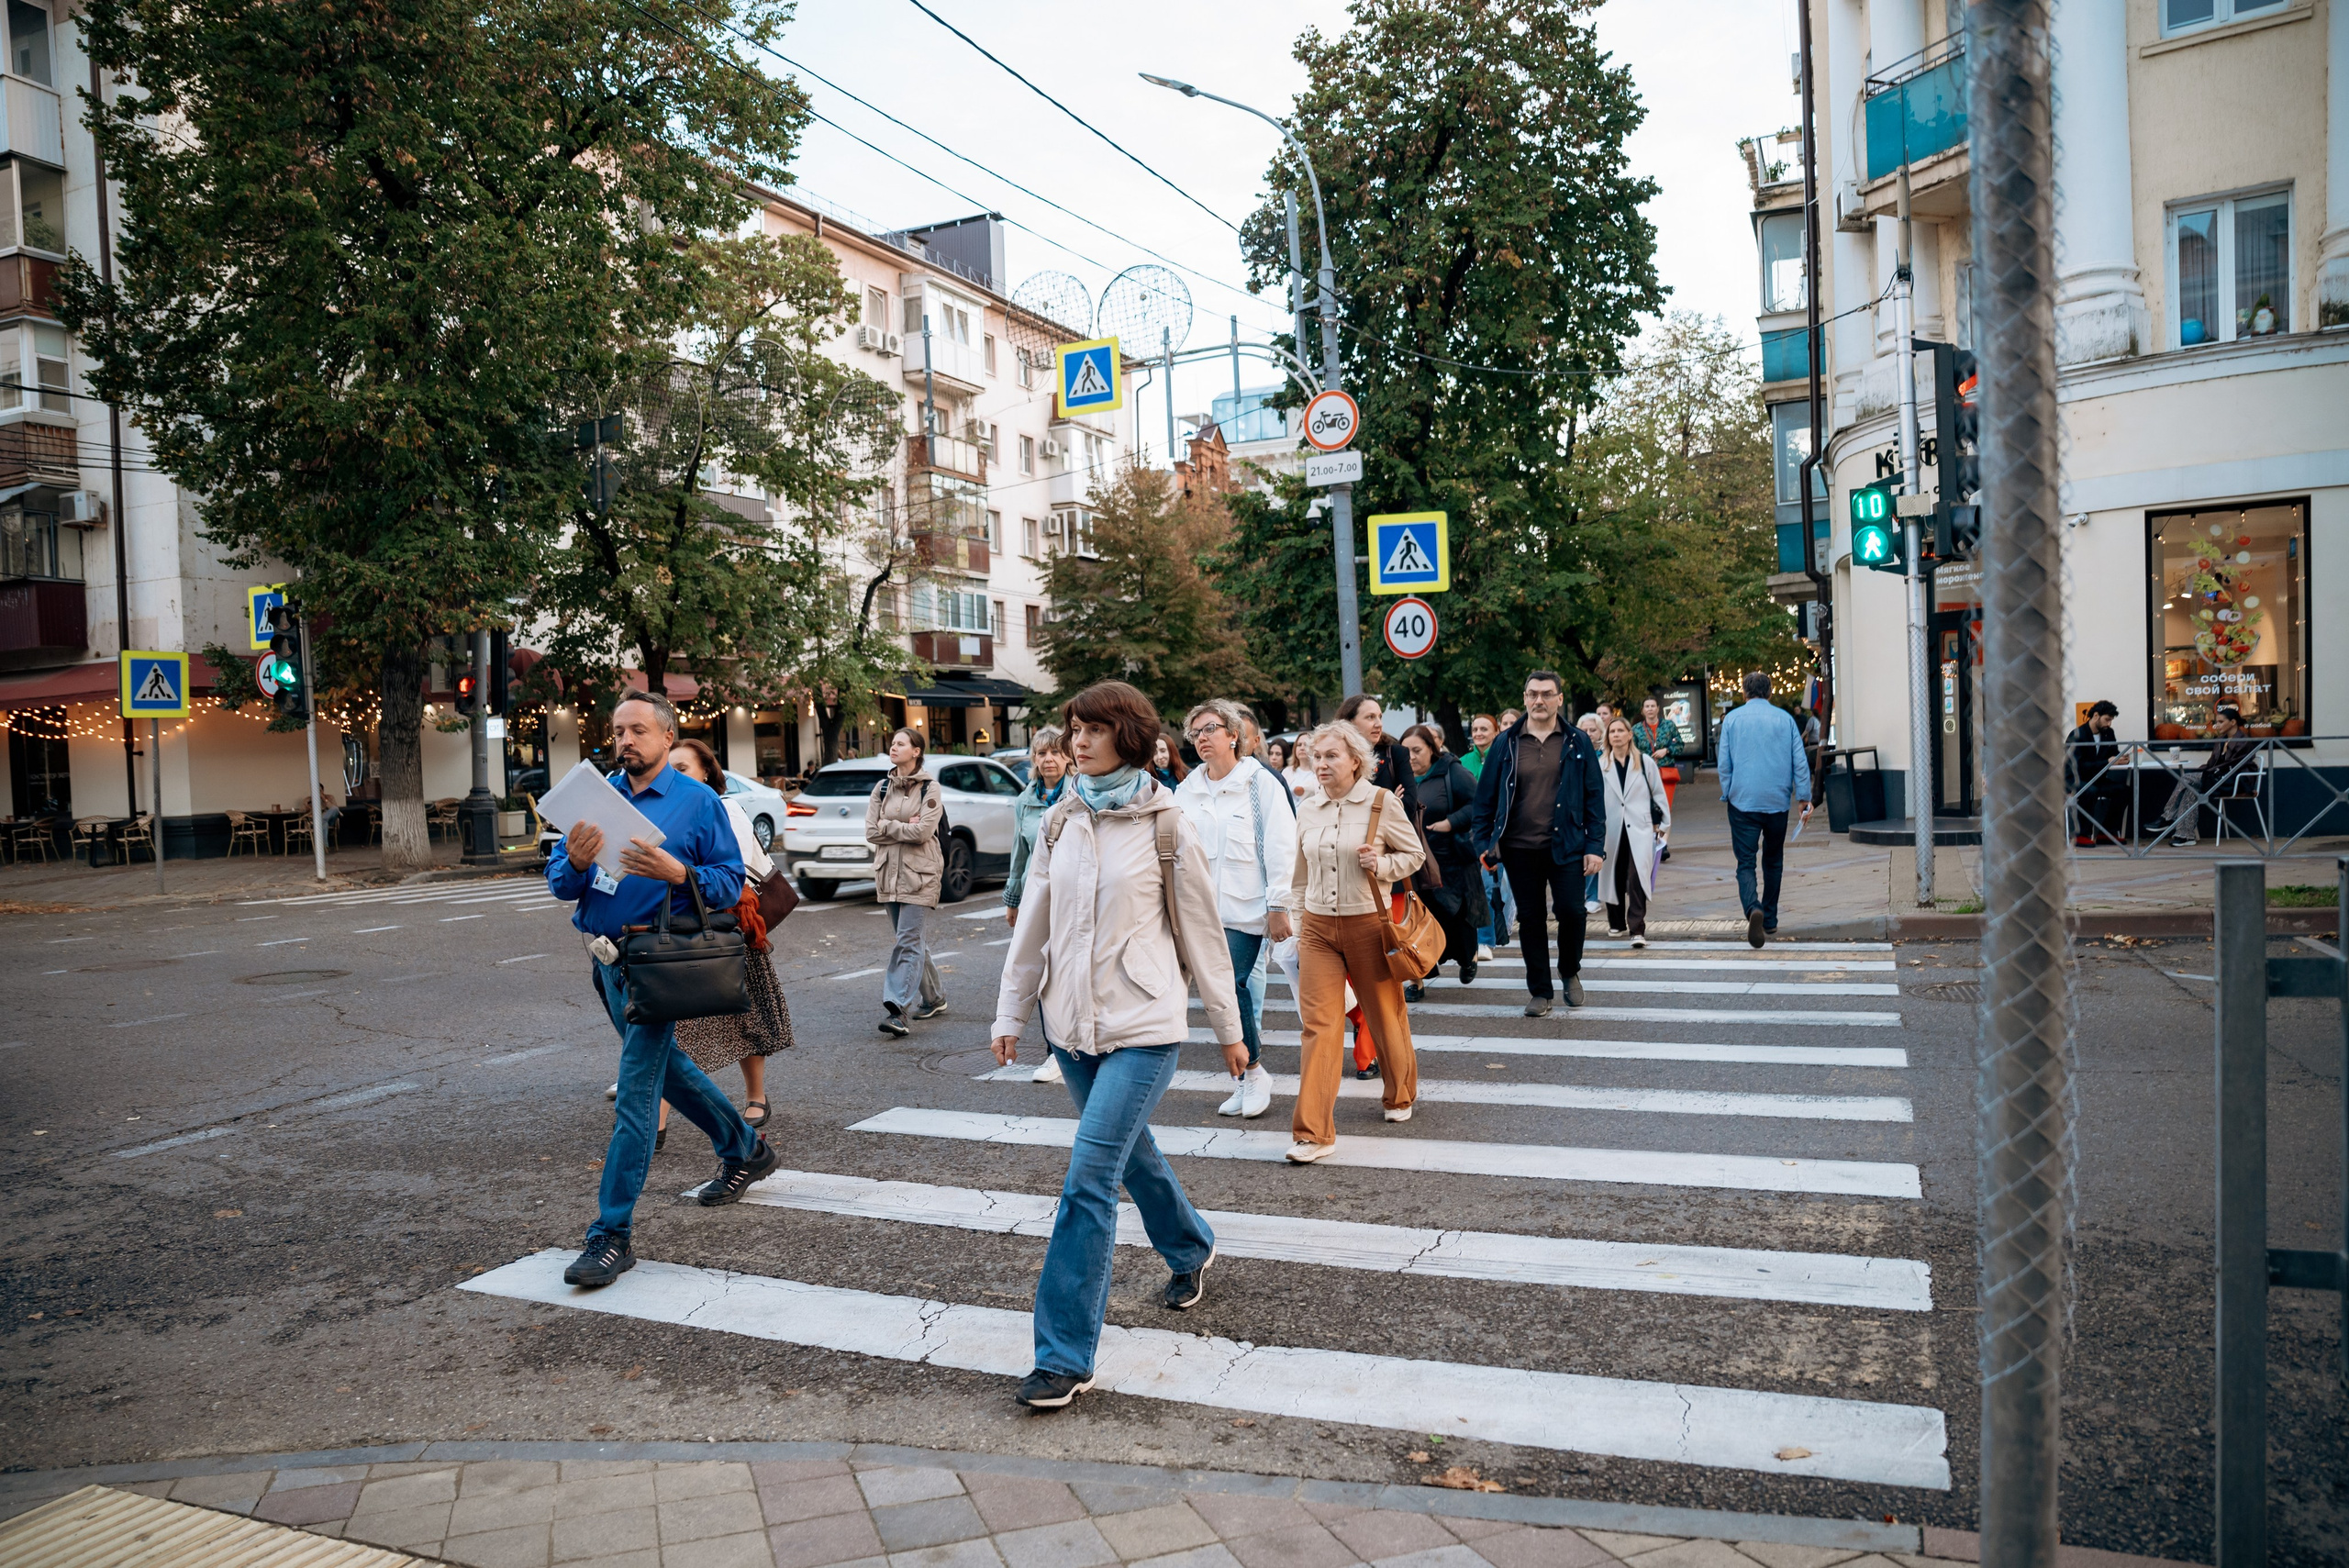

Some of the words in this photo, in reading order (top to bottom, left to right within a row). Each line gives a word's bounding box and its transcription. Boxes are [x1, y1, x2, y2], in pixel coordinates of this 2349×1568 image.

[1310, 462, 1358, 477] 21.00-7.00
[1858, 494, 1883, 518] 10
[1935, 563, 1971, 574] Мягкое
[1935, 572, 1985, 585] морожено
[1394, 614, 1426, 639] 40
[262, 664, 273, 683] 4
[2200, 673, 2255, 684] собери
[2186, 684, 2220, 695] свой
[2224, 683, 2272, 695] салат
